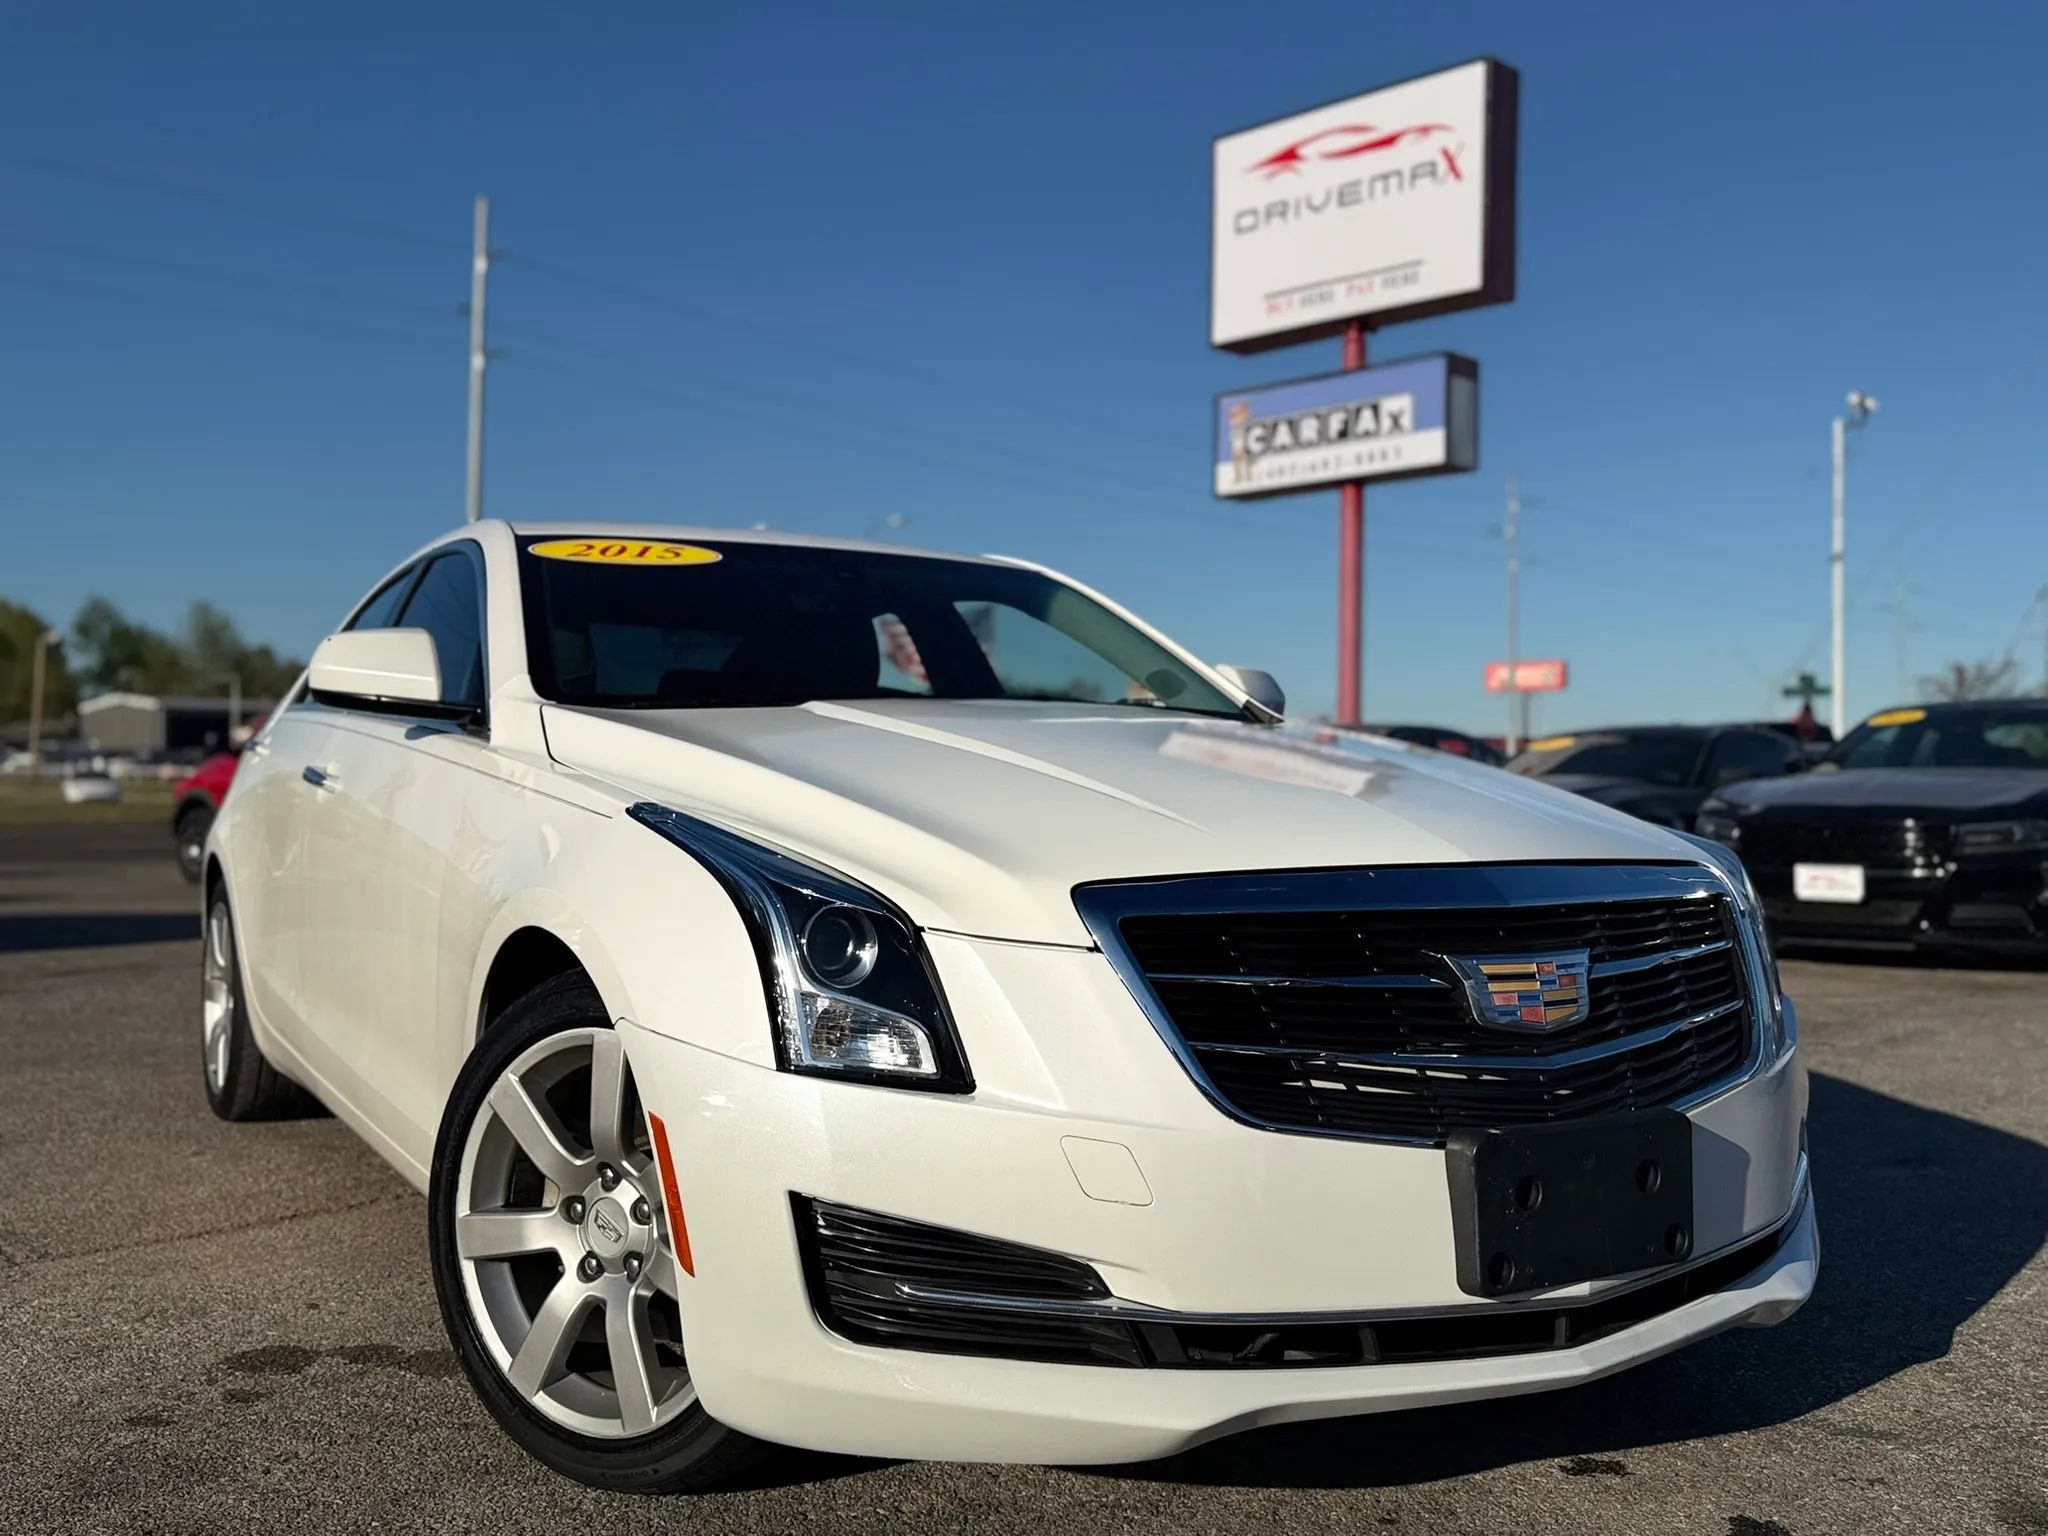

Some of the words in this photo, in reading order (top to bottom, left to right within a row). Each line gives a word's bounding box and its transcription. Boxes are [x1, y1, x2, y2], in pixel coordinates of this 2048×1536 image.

[1233, 142, 1466, 236] DRIVEMAX
[1246, 401, 1408, 454] CARFAX
[566, 543, 685, 559] 2015
